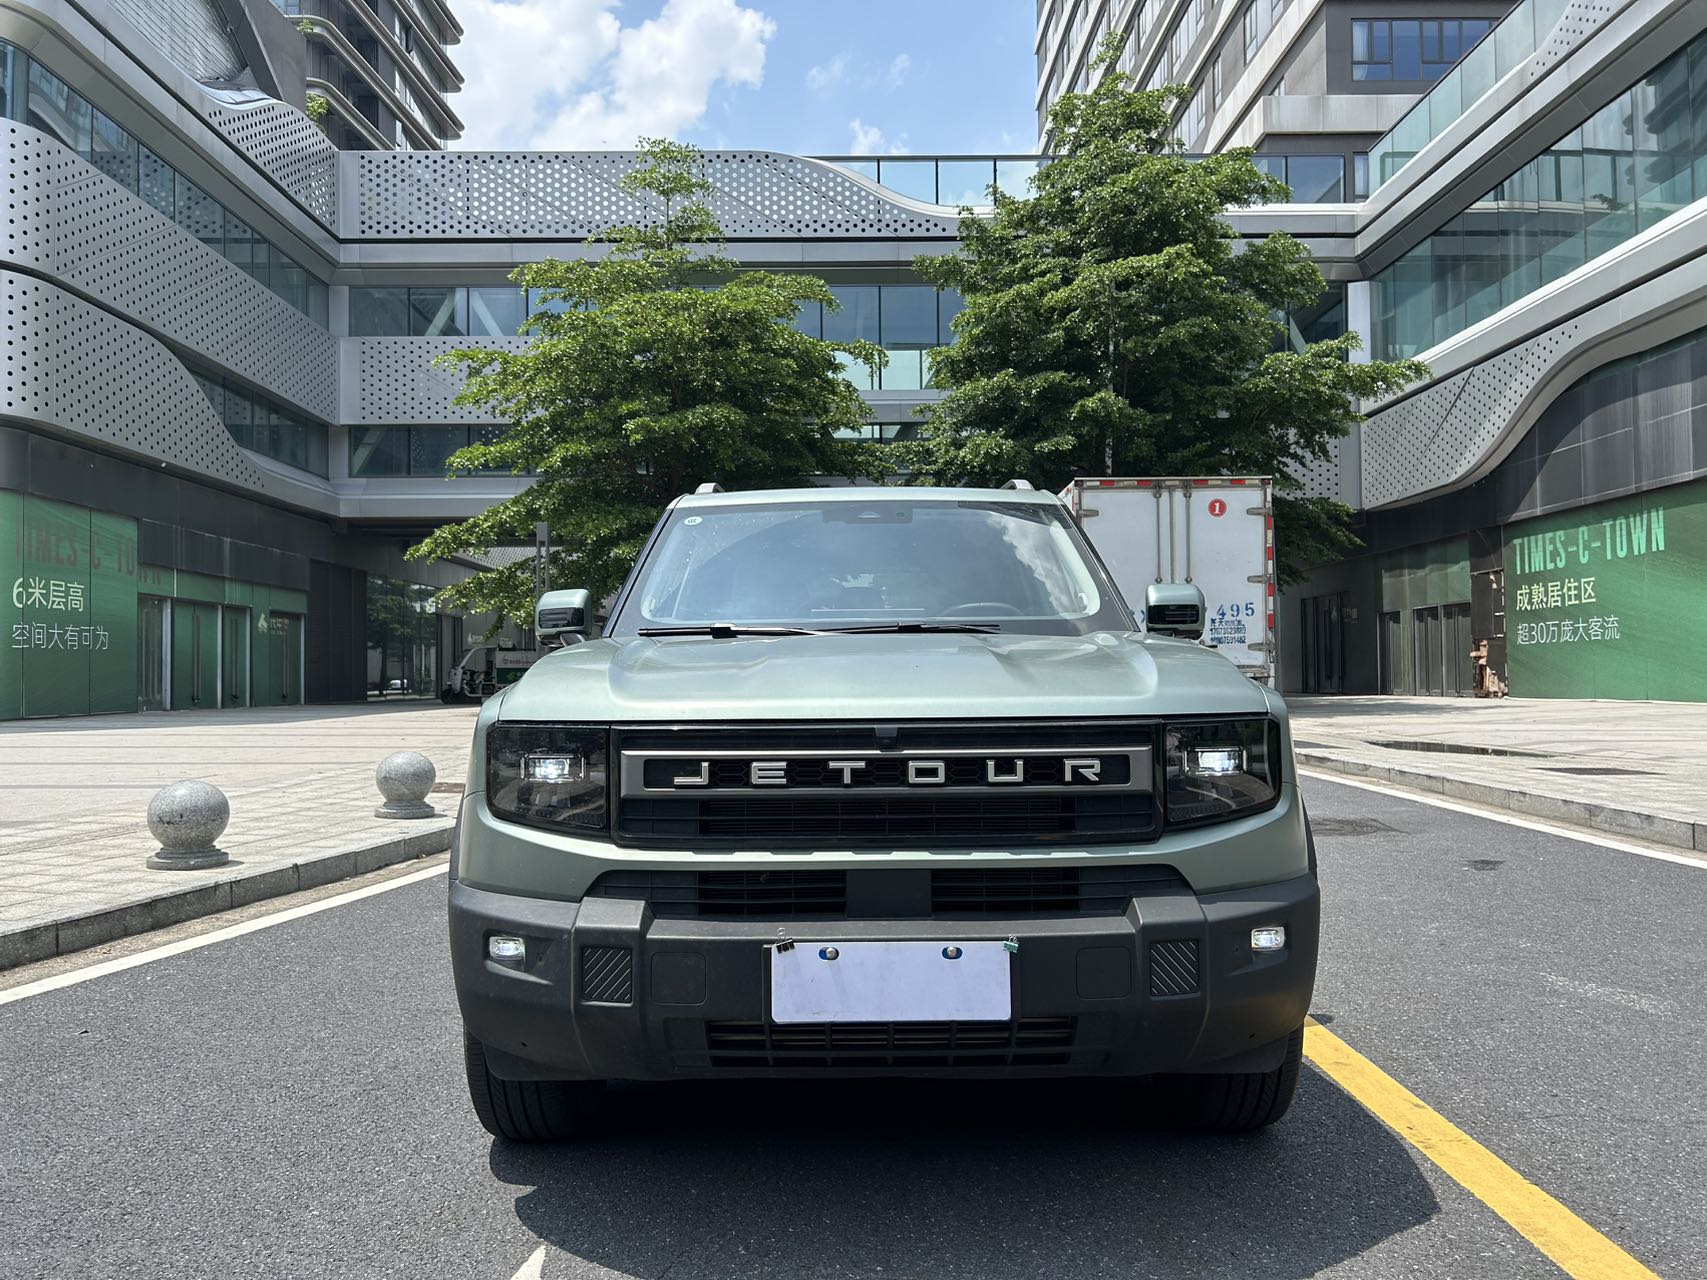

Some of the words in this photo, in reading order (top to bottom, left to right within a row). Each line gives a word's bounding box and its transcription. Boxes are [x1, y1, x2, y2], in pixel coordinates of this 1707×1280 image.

[1512, 507, 1665, 574] TIMES-C-TOWN
[12, 576, 85, 612] 6米层高
[1516, 577, 1597, 611] 成熟居住区
[1216, 602, 1255, 620] 495
[11, 621, 109, 650] 空间大有可为
[1516, 614, 1620, 645] 超30万庞大客流
[673, 760, 1101, 786] JETOUR
